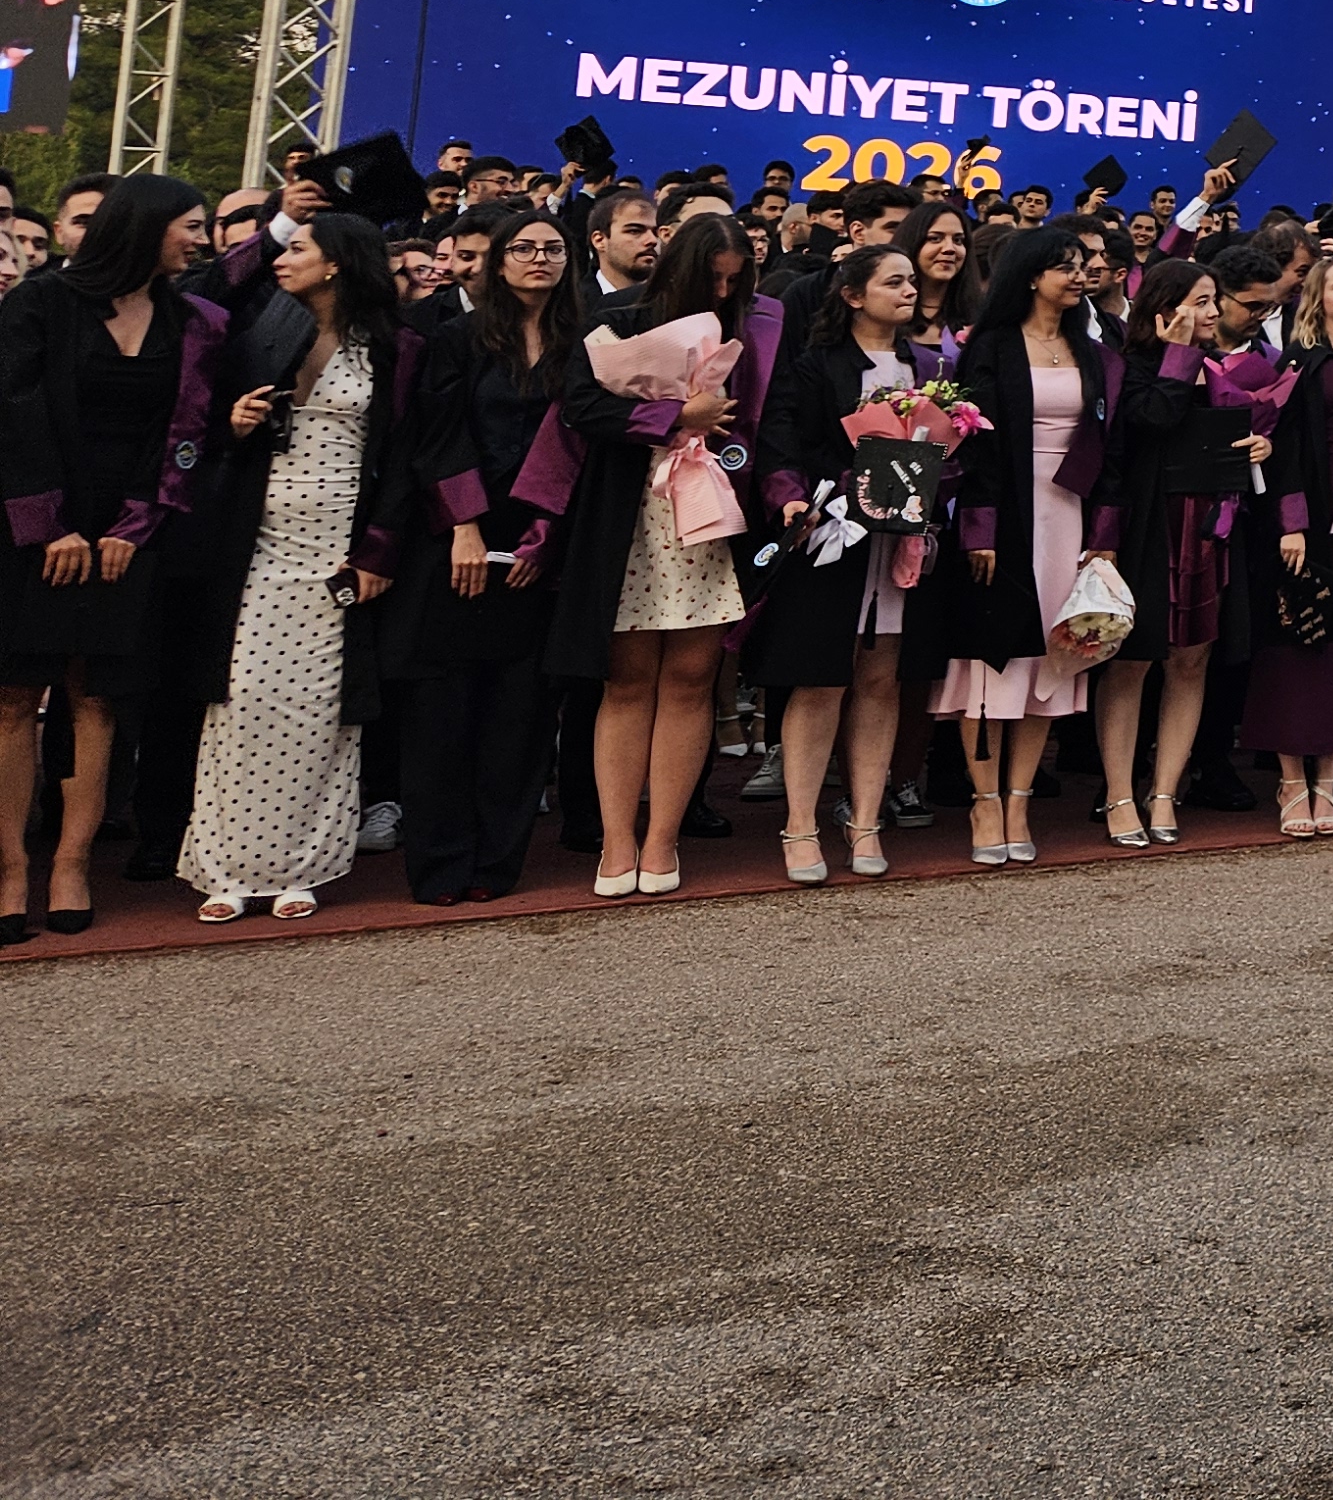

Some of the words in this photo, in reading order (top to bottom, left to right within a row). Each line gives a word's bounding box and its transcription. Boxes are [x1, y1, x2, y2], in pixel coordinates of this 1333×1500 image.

[575, 52, 970, 126] MEZUNİYET
[982, 78, 1199, 143] TÖRENİ
[800, 134, 1002, 200] 2026
